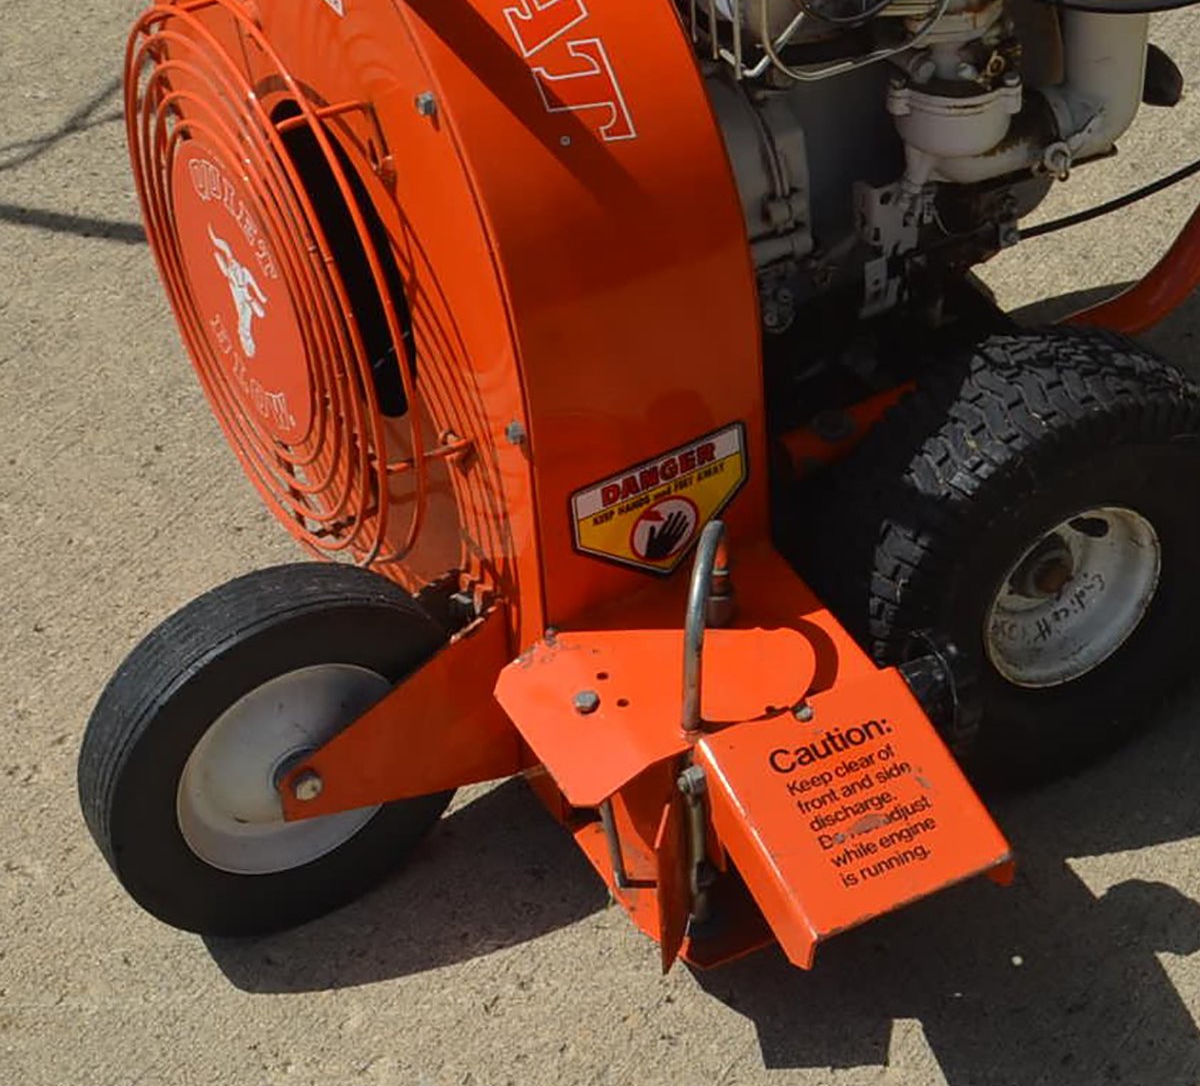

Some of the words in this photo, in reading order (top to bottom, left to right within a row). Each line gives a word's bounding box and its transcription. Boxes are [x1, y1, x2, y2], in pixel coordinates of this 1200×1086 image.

[592, 511, 616, 526] KEEP
[618, 496, 650, 514] HANDS
[674, 477, 693, 492] FEET
[697, 464, 725, 481] AWAY
[601, 442, 717, 507] DANGER
[769, 718, 892, 773] Caution:
[787, 770, 832, 796] Keep
[834, 751, 875, 777] clear
[878, 743, 895, 761] of
[798, 790, 839, 814] front
[841, 774, 872, 798] and
[875, 761, 911, 784] side
[809, 791, 897, 832] discharge.
[832, 839, 878, 868] while
[879, 817, 936, 848] engine
[840, 873, 859, 888] is
[860, 843, 931, 879] running.
